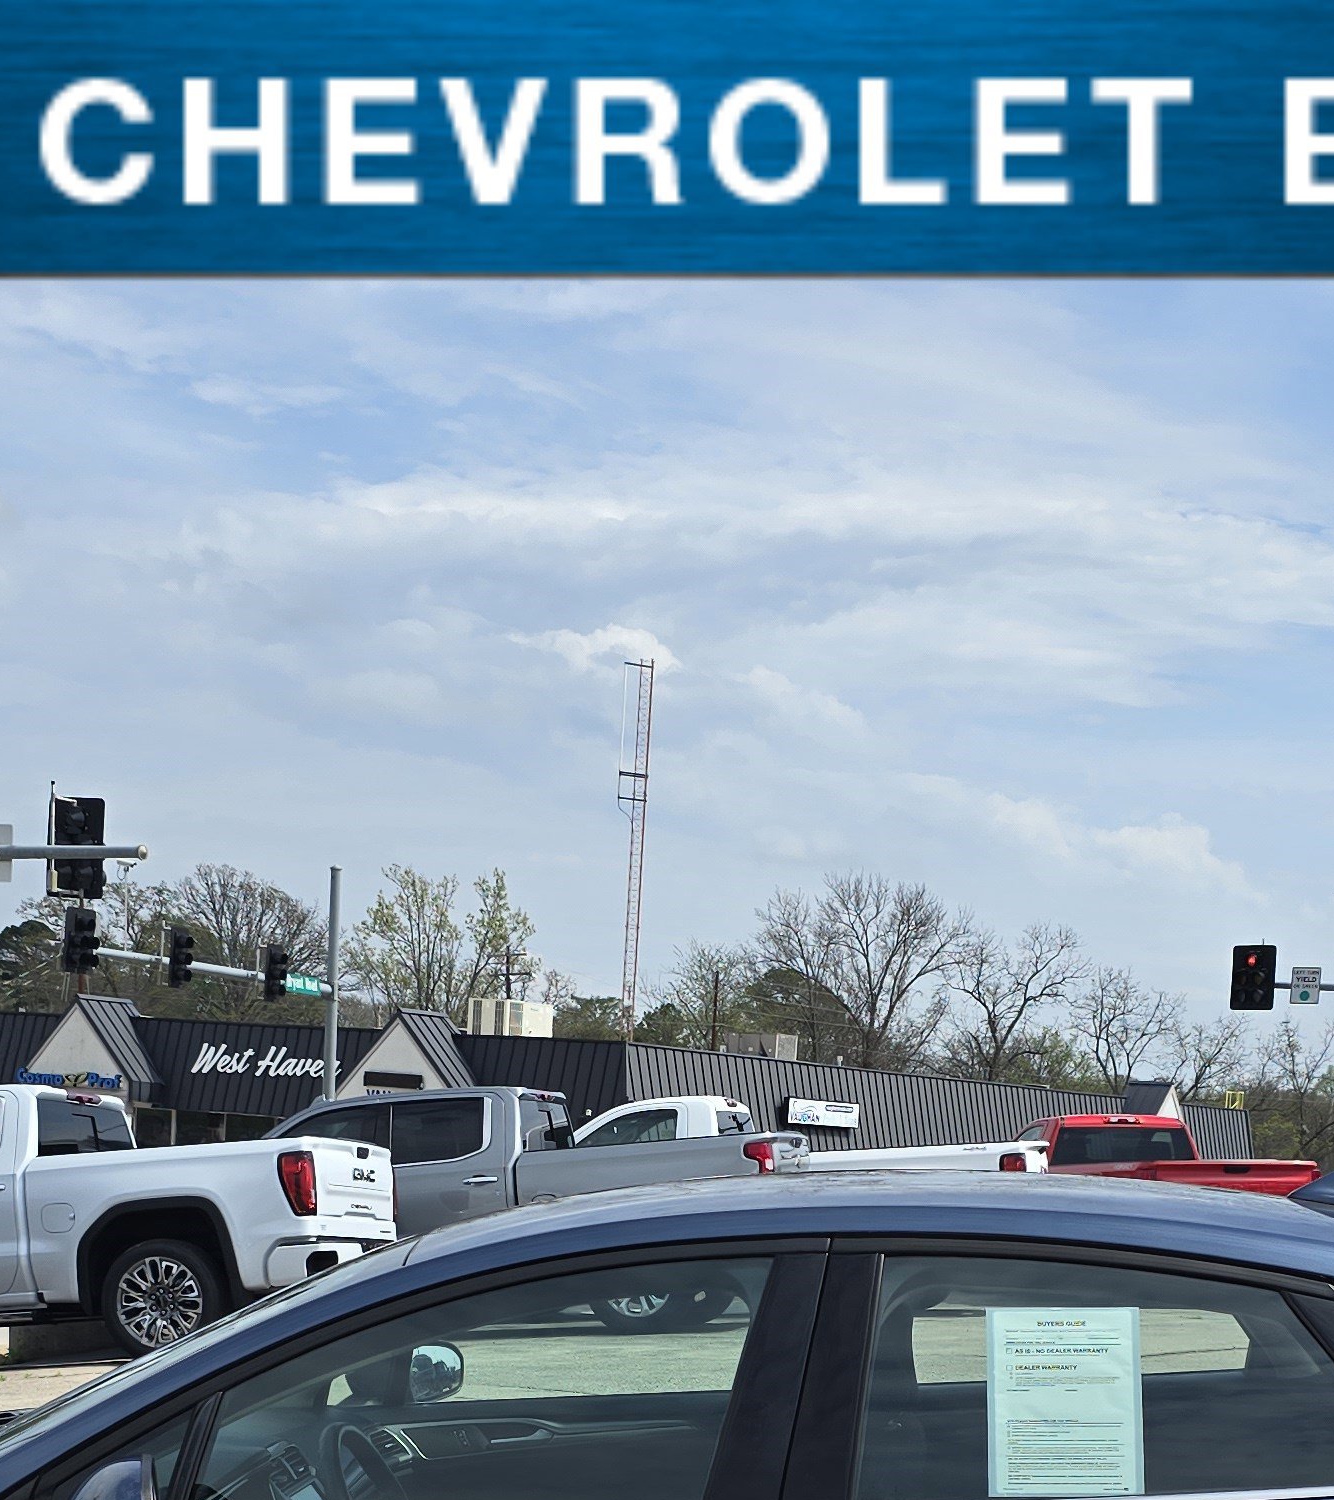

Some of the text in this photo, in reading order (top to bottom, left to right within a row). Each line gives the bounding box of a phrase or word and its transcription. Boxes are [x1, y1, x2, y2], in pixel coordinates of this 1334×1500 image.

[190, 1042, 256, 1074] West
[16, 1067, 123, 1088] Cosmo Prof
